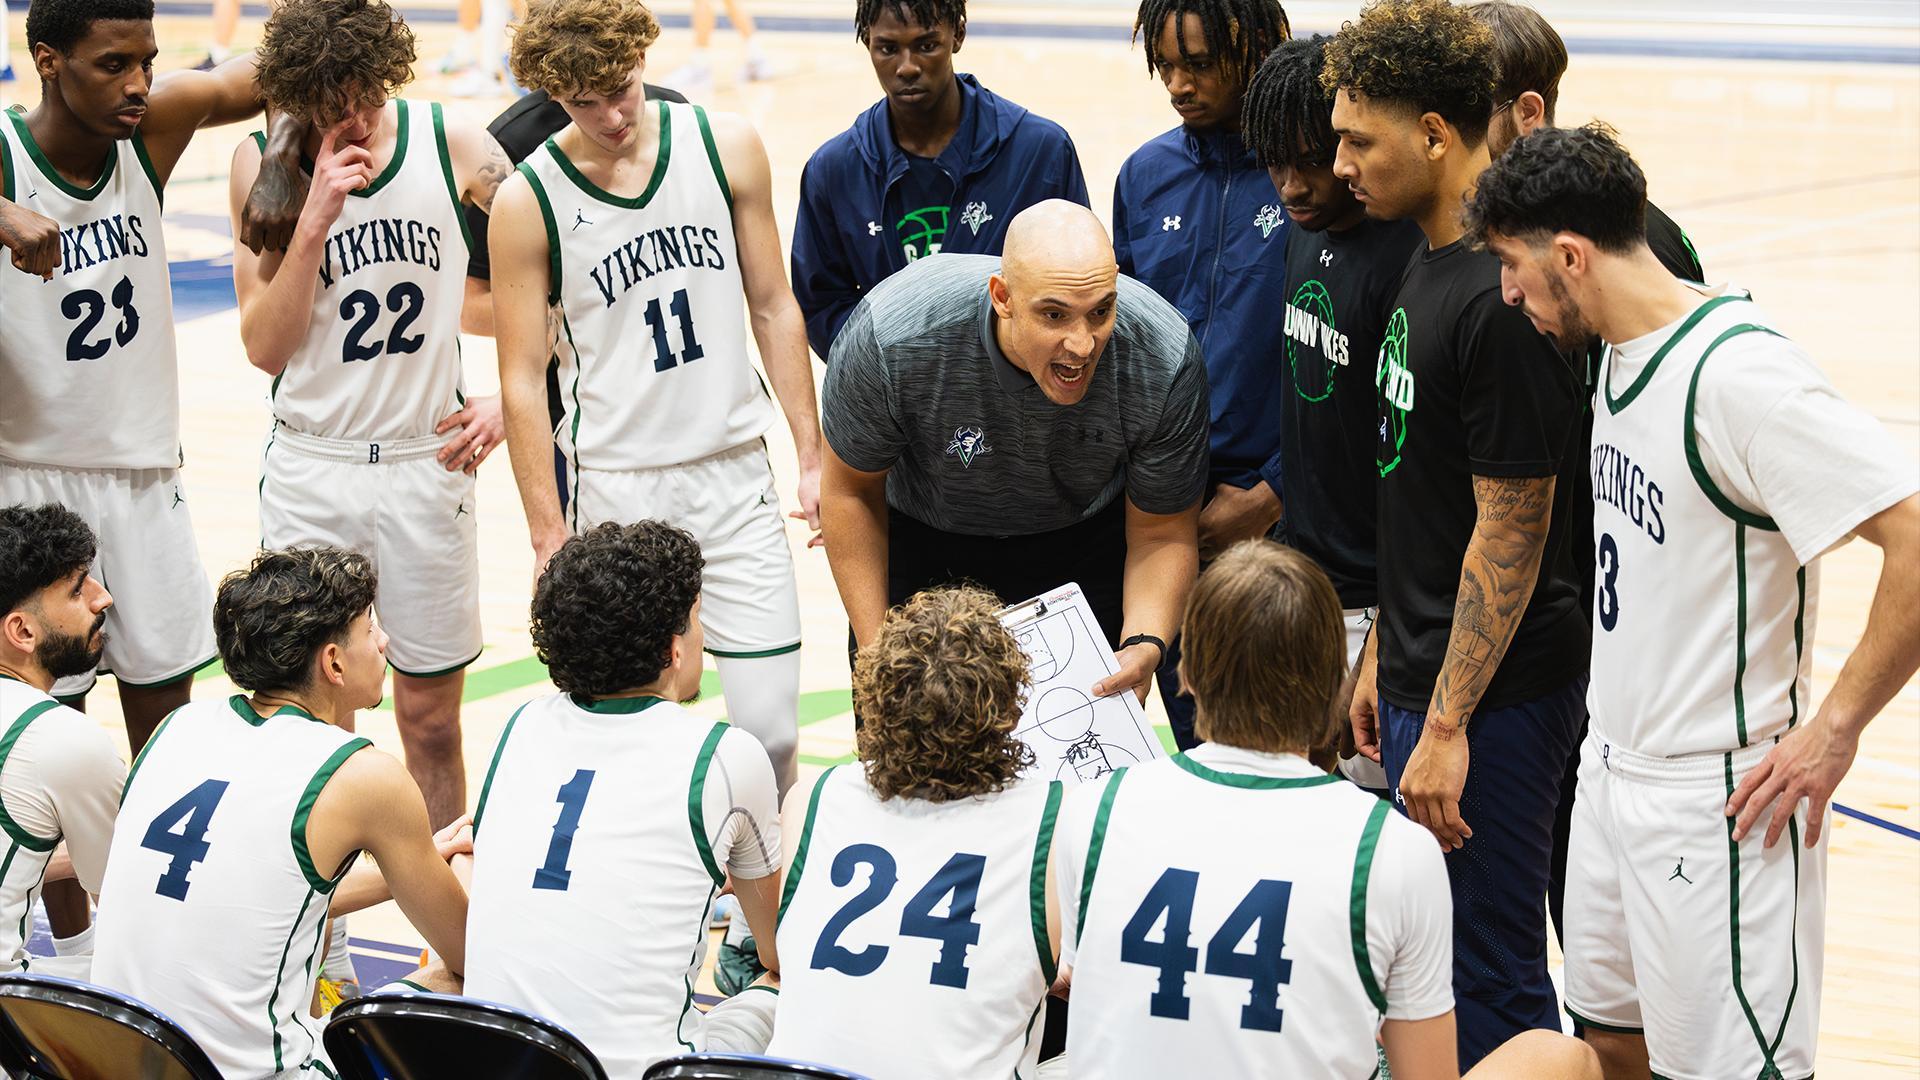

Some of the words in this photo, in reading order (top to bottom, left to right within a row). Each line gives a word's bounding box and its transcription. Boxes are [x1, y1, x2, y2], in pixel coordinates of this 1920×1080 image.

[589, 224, 725, 309] VIKINGS
[61, 275, 141, 362] 23
[340, 281, 426, 364] 22
[643, 288, 705, 373] 11
[368, 443, 380, 464] B
[1599, 532, 1620, 632] 3
[140, 778, 230, 902] 4
[532, 768, 596, 891] 1
[809, 843, 987, 990] 24
[1120, 867, 1293, 1033] 44
